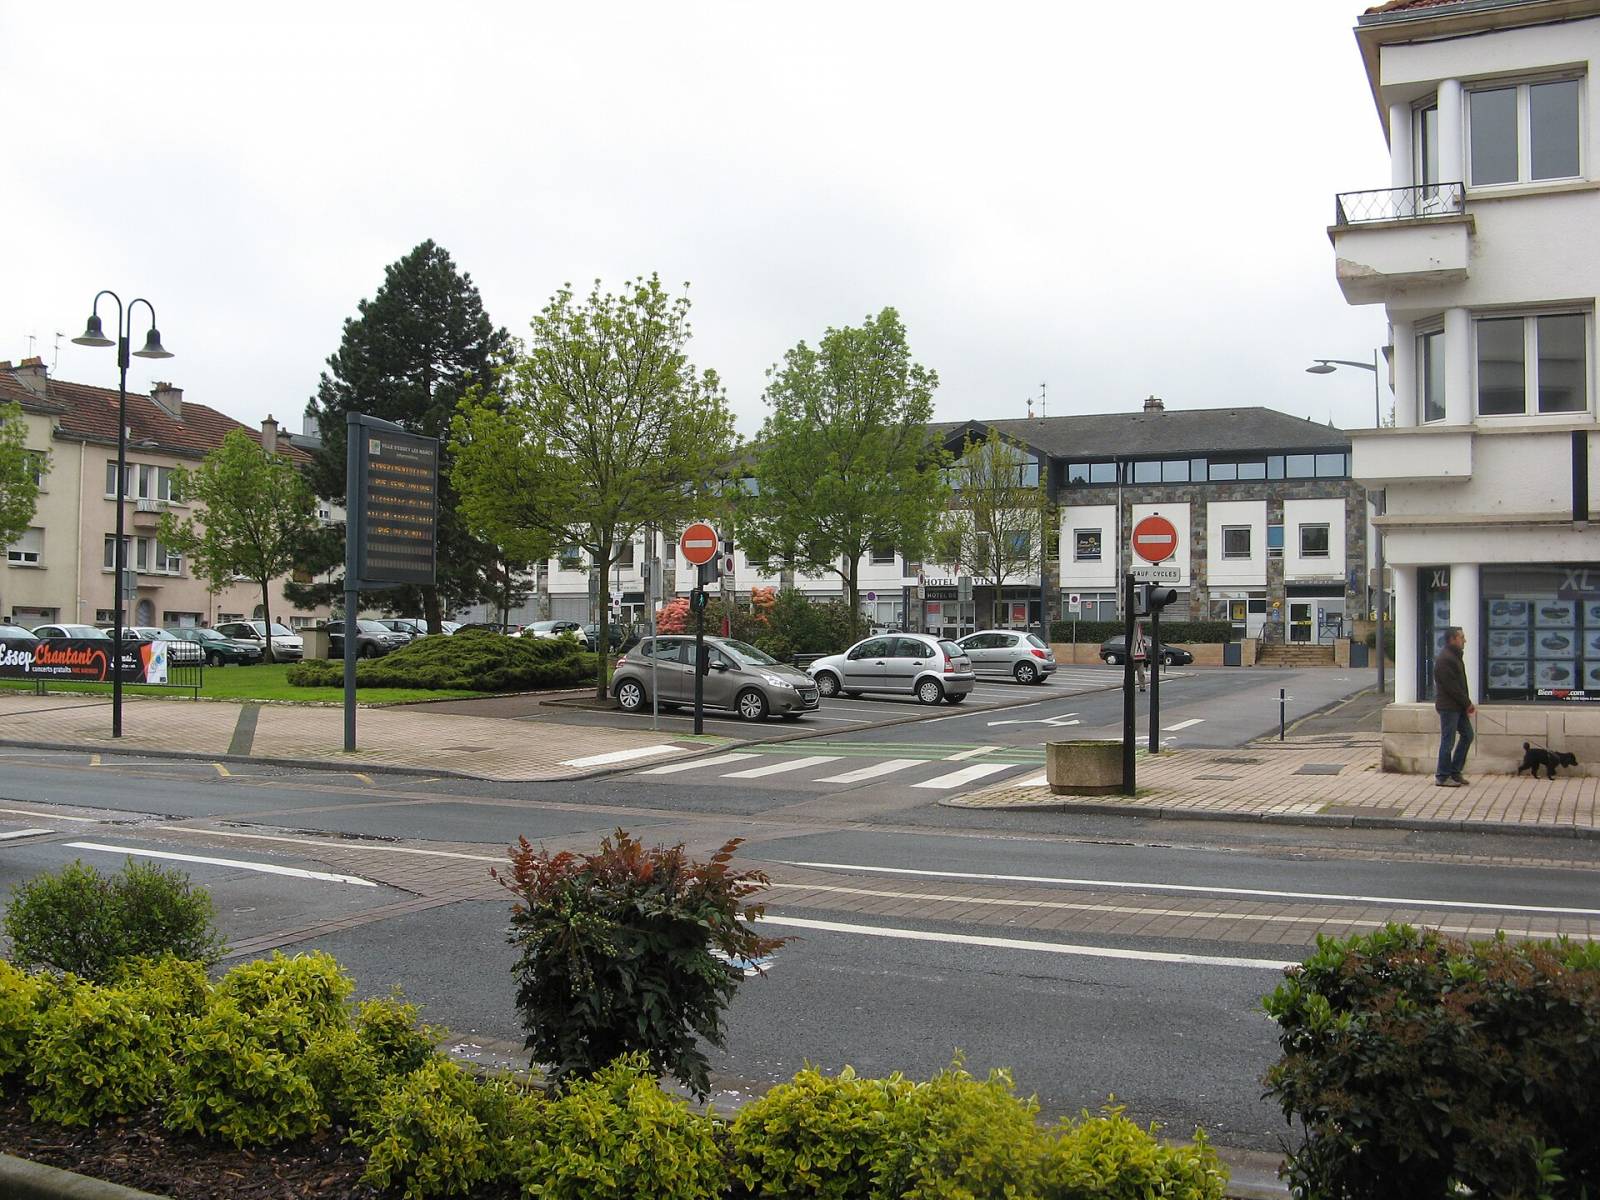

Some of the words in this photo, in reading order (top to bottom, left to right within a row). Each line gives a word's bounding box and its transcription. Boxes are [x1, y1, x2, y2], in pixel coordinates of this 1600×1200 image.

[924, 578, 955, 586] HOTEL
[1431, 570, 1448, 588] XL
[1560, 569, 1595, 591] XL
[927, 592, 947, 600] HOTEL
[0, 643, 36, 673] Essey
[35, 644, 98, 667] Chantant
